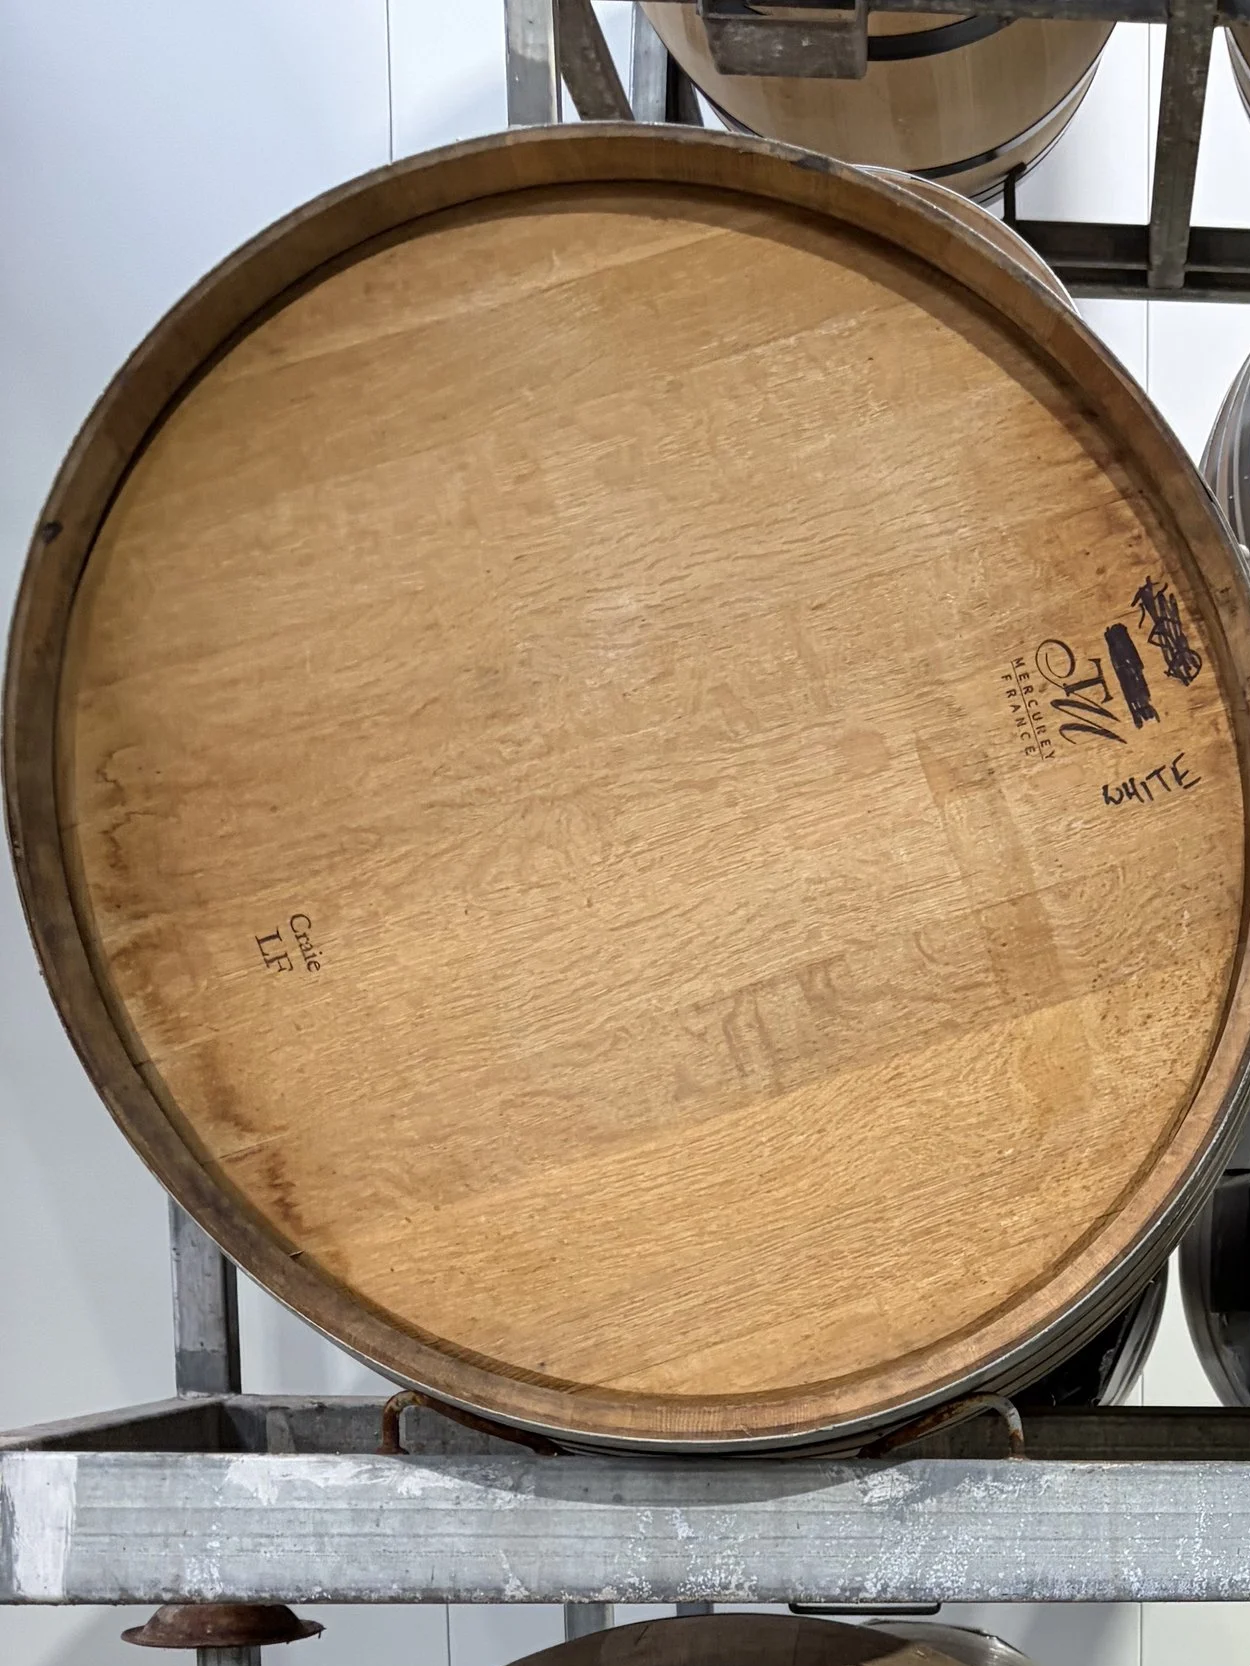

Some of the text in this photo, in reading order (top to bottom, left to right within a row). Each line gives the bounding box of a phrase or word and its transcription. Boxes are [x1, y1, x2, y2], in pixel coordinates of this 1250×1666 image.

[1001, 673, 1036, 756] FRANCE
[1012, 656, 1056, 761] MERCUREY
[1102, 752, 1202, 805] WHITE
[255, 926, 293, 972] LF
[290, 914, 323, 972] Craie
